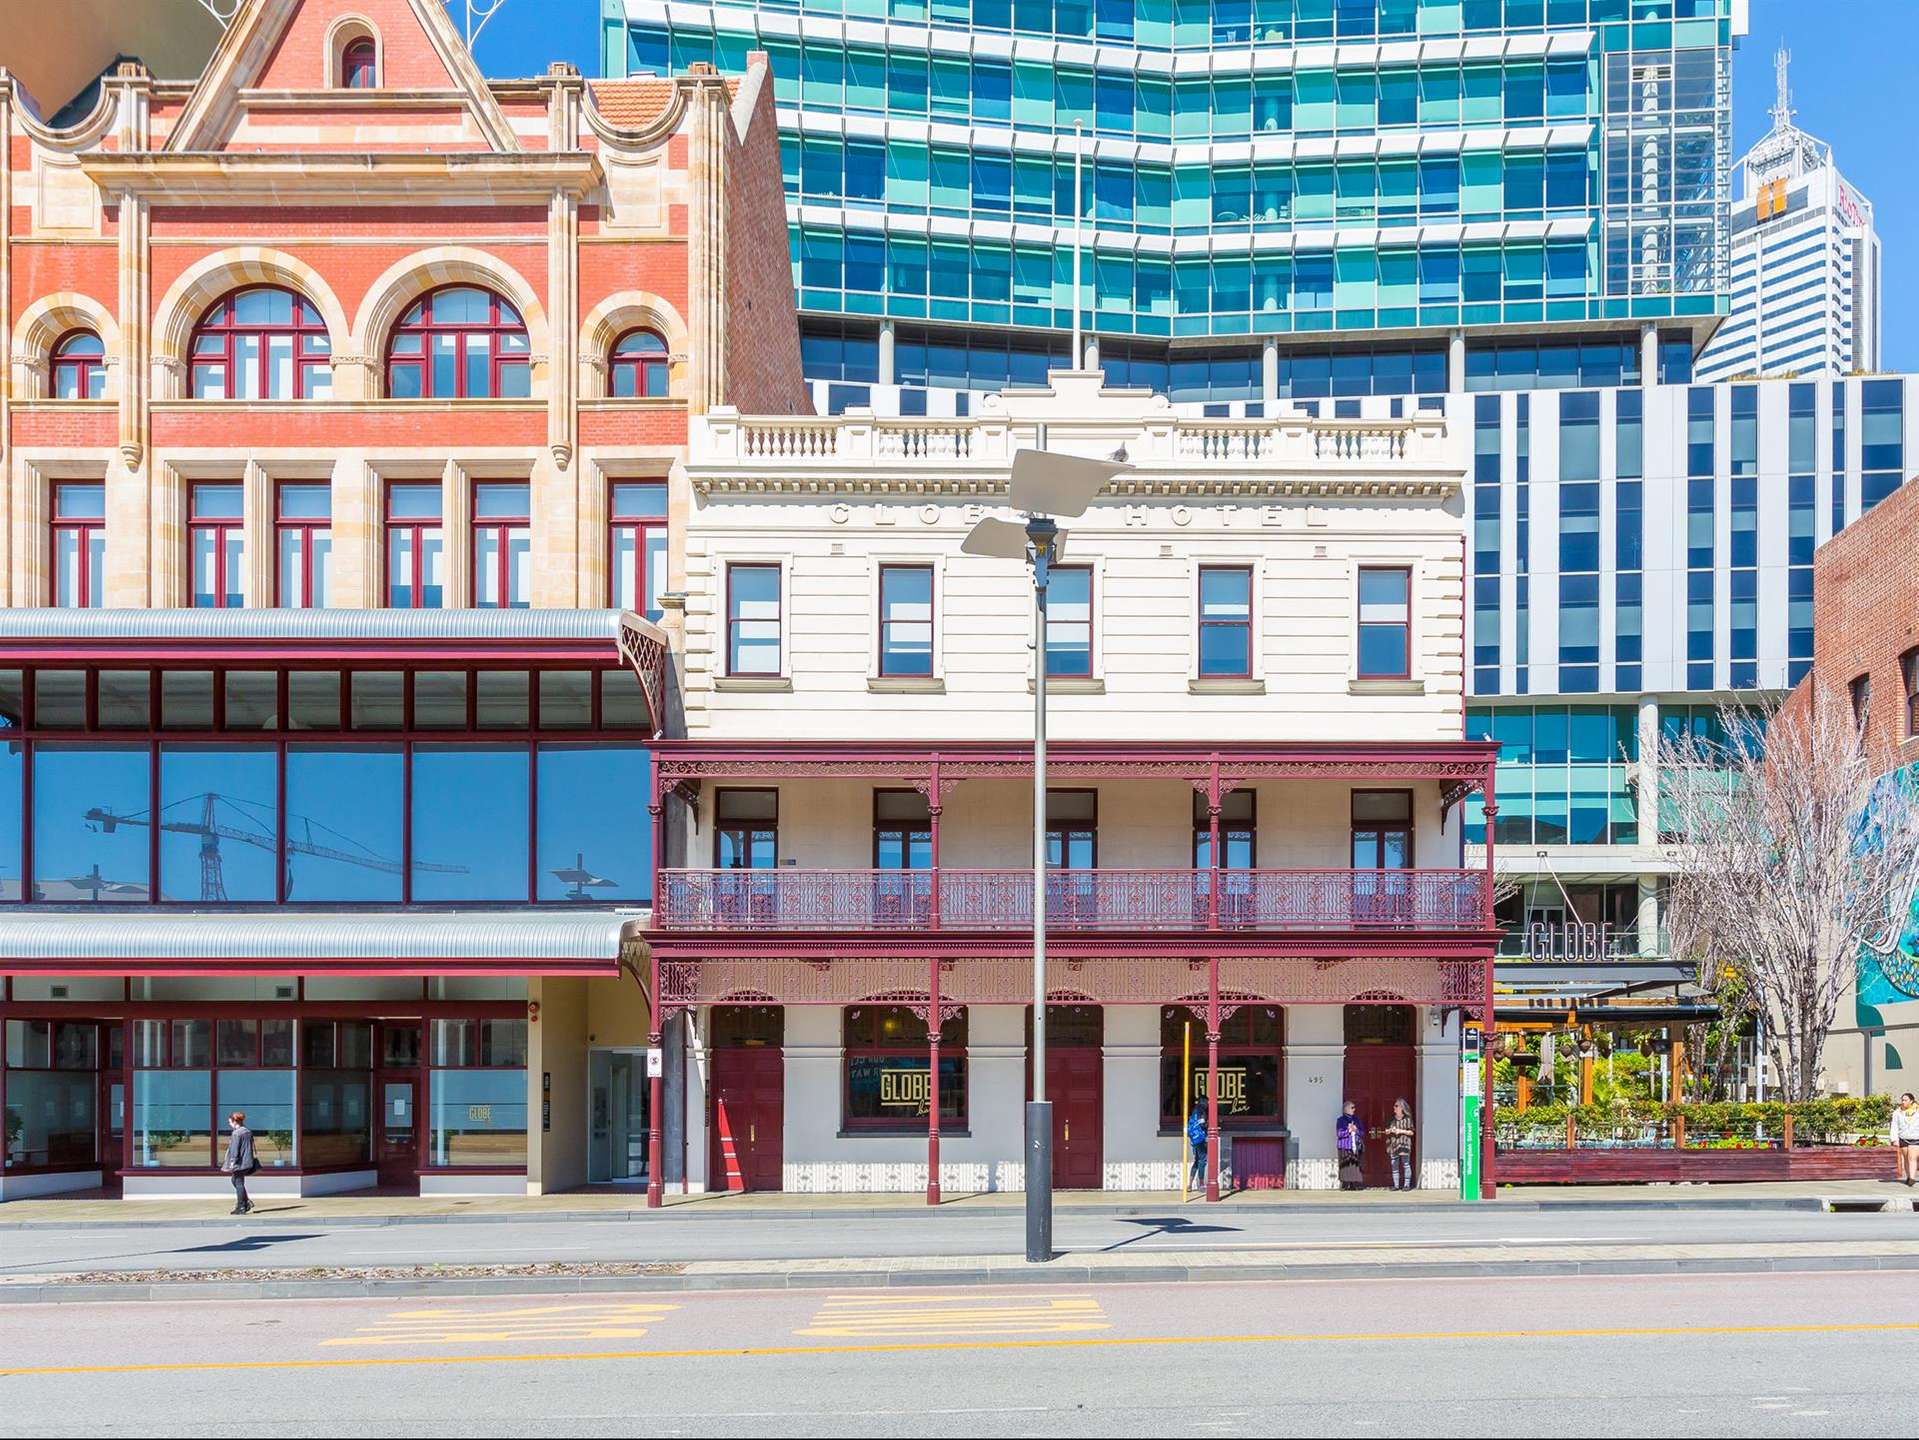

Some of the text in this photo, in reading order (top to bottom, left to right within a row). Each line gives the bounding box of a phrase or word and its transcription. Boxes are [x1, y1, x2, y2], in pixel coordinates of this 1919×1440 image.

[830, 503, 1328, 527] GLOB HOTEL
[1530, 921, 1614, 962] GLOBE
[881, 1074, 931, 1100] GLOBE
[915, 1099, 931, 1117] ba
[1229, 1097, 1250, 1115] bar
[318, 1304, 682, 1346] BUS
